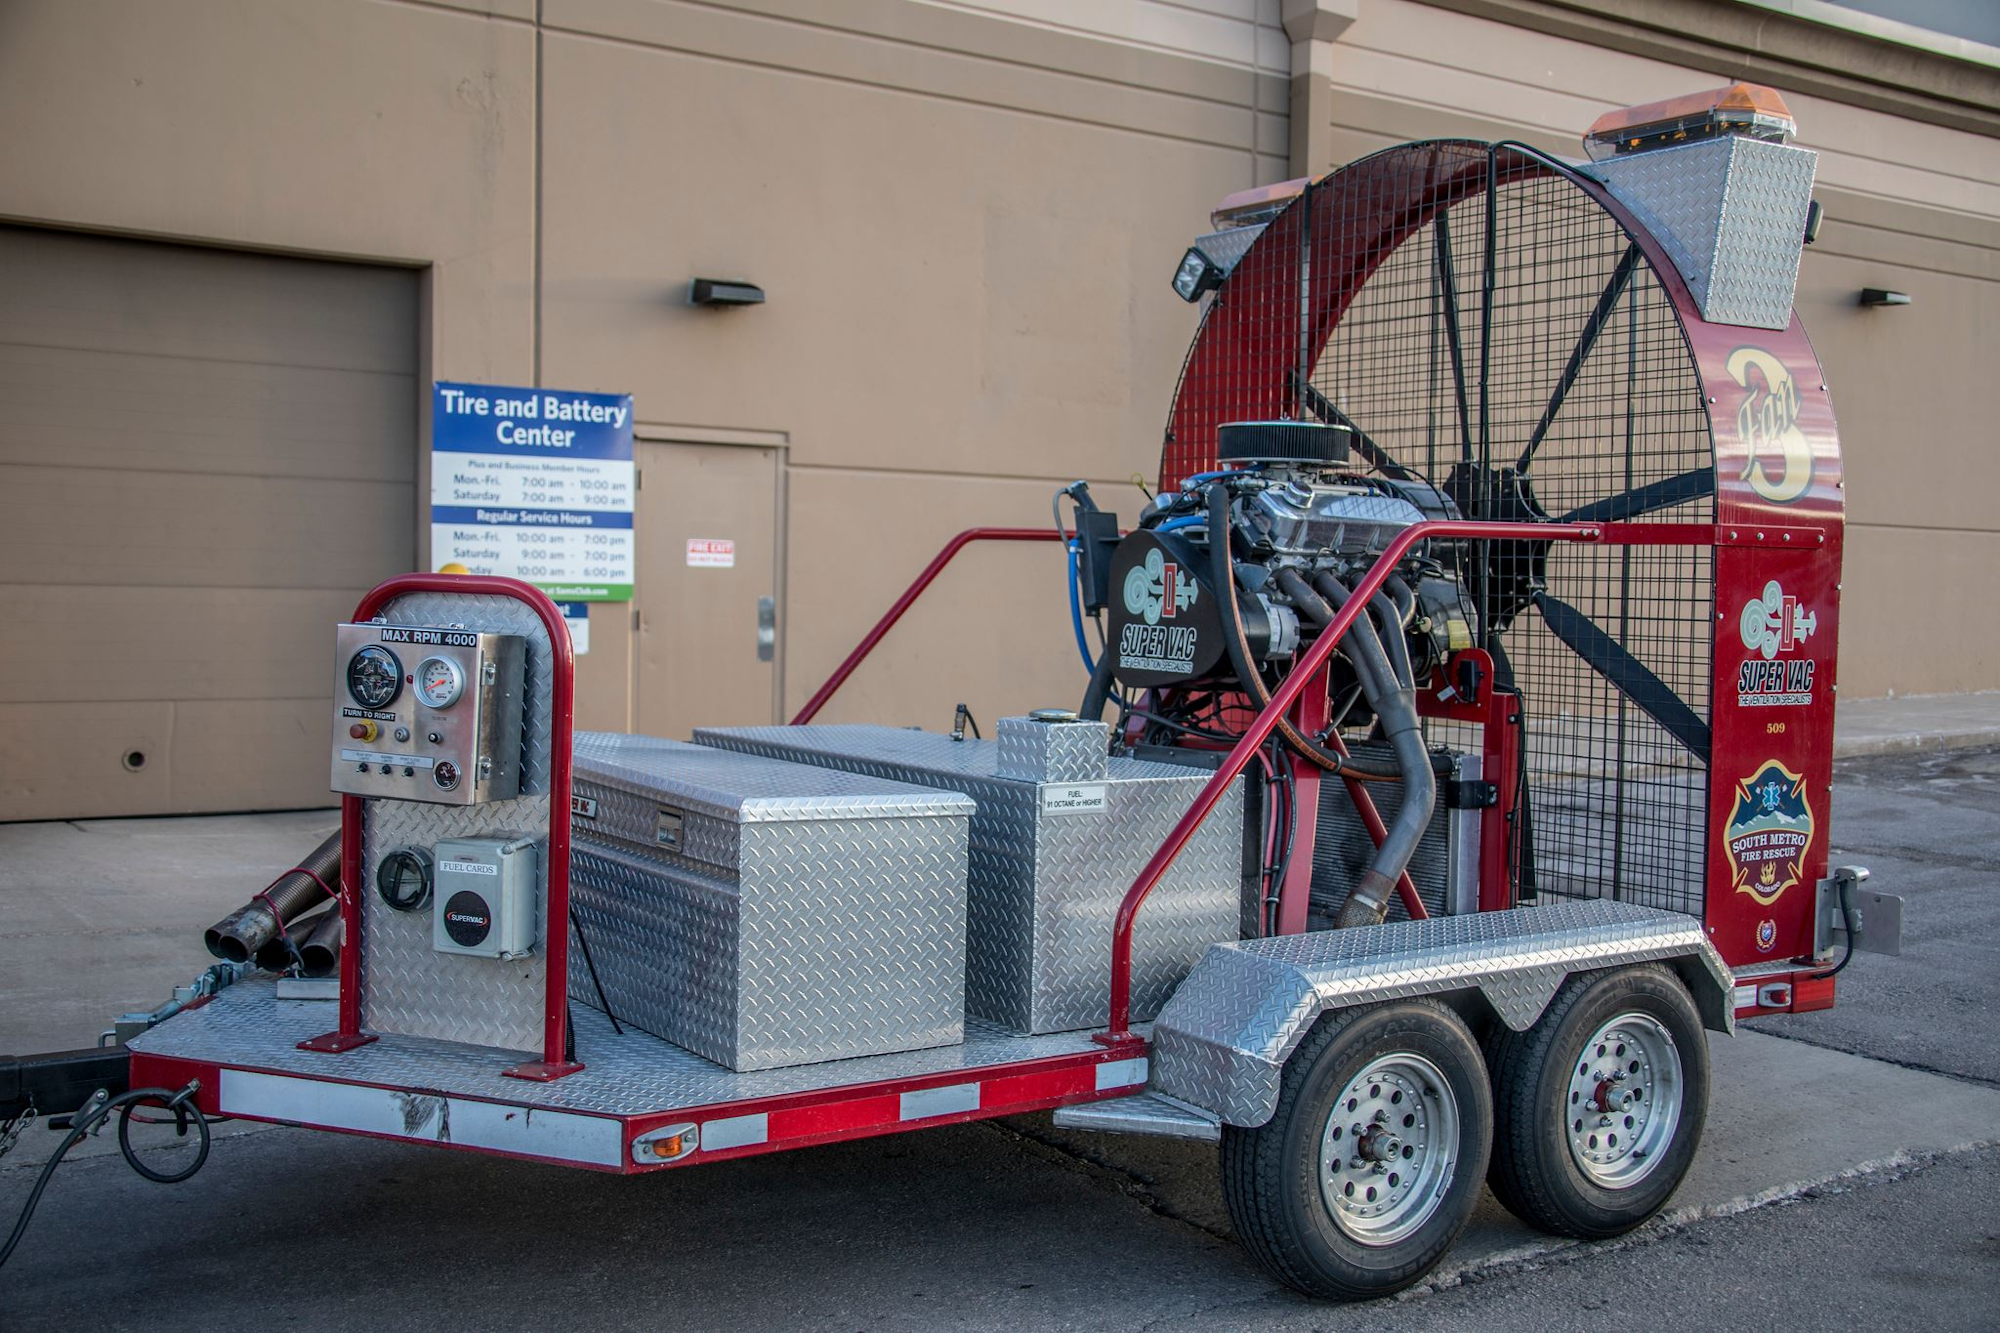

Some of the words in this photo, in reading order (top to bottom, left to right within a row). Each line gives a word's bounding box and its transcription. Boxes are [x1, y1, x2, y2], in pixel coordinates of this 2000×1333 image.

[440, 388, 490, 416] Tire
[494, 394, 538, 419] and
[543, 396, 627, 429] Battery
[496, 420, 576, 448] Center
[468, 460, 486, 469] Plus
[488, 461, 503, 470] and
[505, 462, 540, 471] Business
[542, 464, 575, 473] Member
[577, 465, 600, 474] Hours
[453, 474, 501, 486] Mon.-Fri.
[522, 476, 546, 488] 7:00
[548, 480, 564, 488] am
[580, 479, 609, 491] 10:00
[611, 482, 627, 491] am
[453, 489, 501, 502] Saturday
[522, 492, 546, 503] 7:00
[548, 495, 564, 504] am
[584, 494, 609, 505] 9:00
[611, 498, 626, 506] am
[476, 509, 518, 523] Regular
[520, 509, 559, 523] Service
[560, 511, 593, 525] Hours
[453, 531, 501, 543] Mon.-Fri.
[516, 532, 547, 544] 10:00
[549, 535, 565, 544] am
[584, 534, 608, 545] 7:00
[610, 537, 626, 547] pm
[453, 548, 501, 561] Saturday
[522, 549, 547, 560] 9:00
[549, 552, 565, 560] am
[584, 550, 608, 561] 7:00
[610, 554, 626, 564] pm
[468, 565, 493, 576] nday
[516, 565, 547, 577] 10:00
[549, 568, 565, 577] am
[584, 566, 608, 578] 6:00
[610, 569, 626, 580] pm
[381, 629, 410, 643] MAX
[413, 631, 442, 645] RPM
[444, 633, 477, 647] 4000
[1120, 623, 1168, 658] SUPER
[1167, 626, 1197, 661] VAC
[1131, 658, 1161, 670] VENTILATION
[1161, 660, 1193, 673] SPECIALISTS
[1738, 660, 1786, 693] SUPER
[1786, 659, 1815, 692] VAC
[1739, 695, 1750, 705] THE
[1750, 695, 1781, 705] VENTILATION
[1781, 693, 1811, 704] SPECIALISTS
[343, 708, 362, 717] TURN
[363, 710, 373, 718] TO
[374, 712, 395, 721] RIGHT
[1766, 722, 1786, 734] 509
[1067, 790, 1083, 798] FUEL:
[1054, 799, 1075, 808] OCTANE
[1082, 798, 1102, 806] HIGHER
[1732, 833, 1768, 854] SOUTH
[1769, 833, 1806, 847] METRO
[1740, 850, 1762, 862] FIRE
[1763, 847, 1796, 860] RESCUE
[443, 862, 464, 871] FUEL
[465, 864, 494, 874] CARDS
[1754, 880, 1781, 893] COLORADO
[451, 914, 484, 924] SUPERVAC
